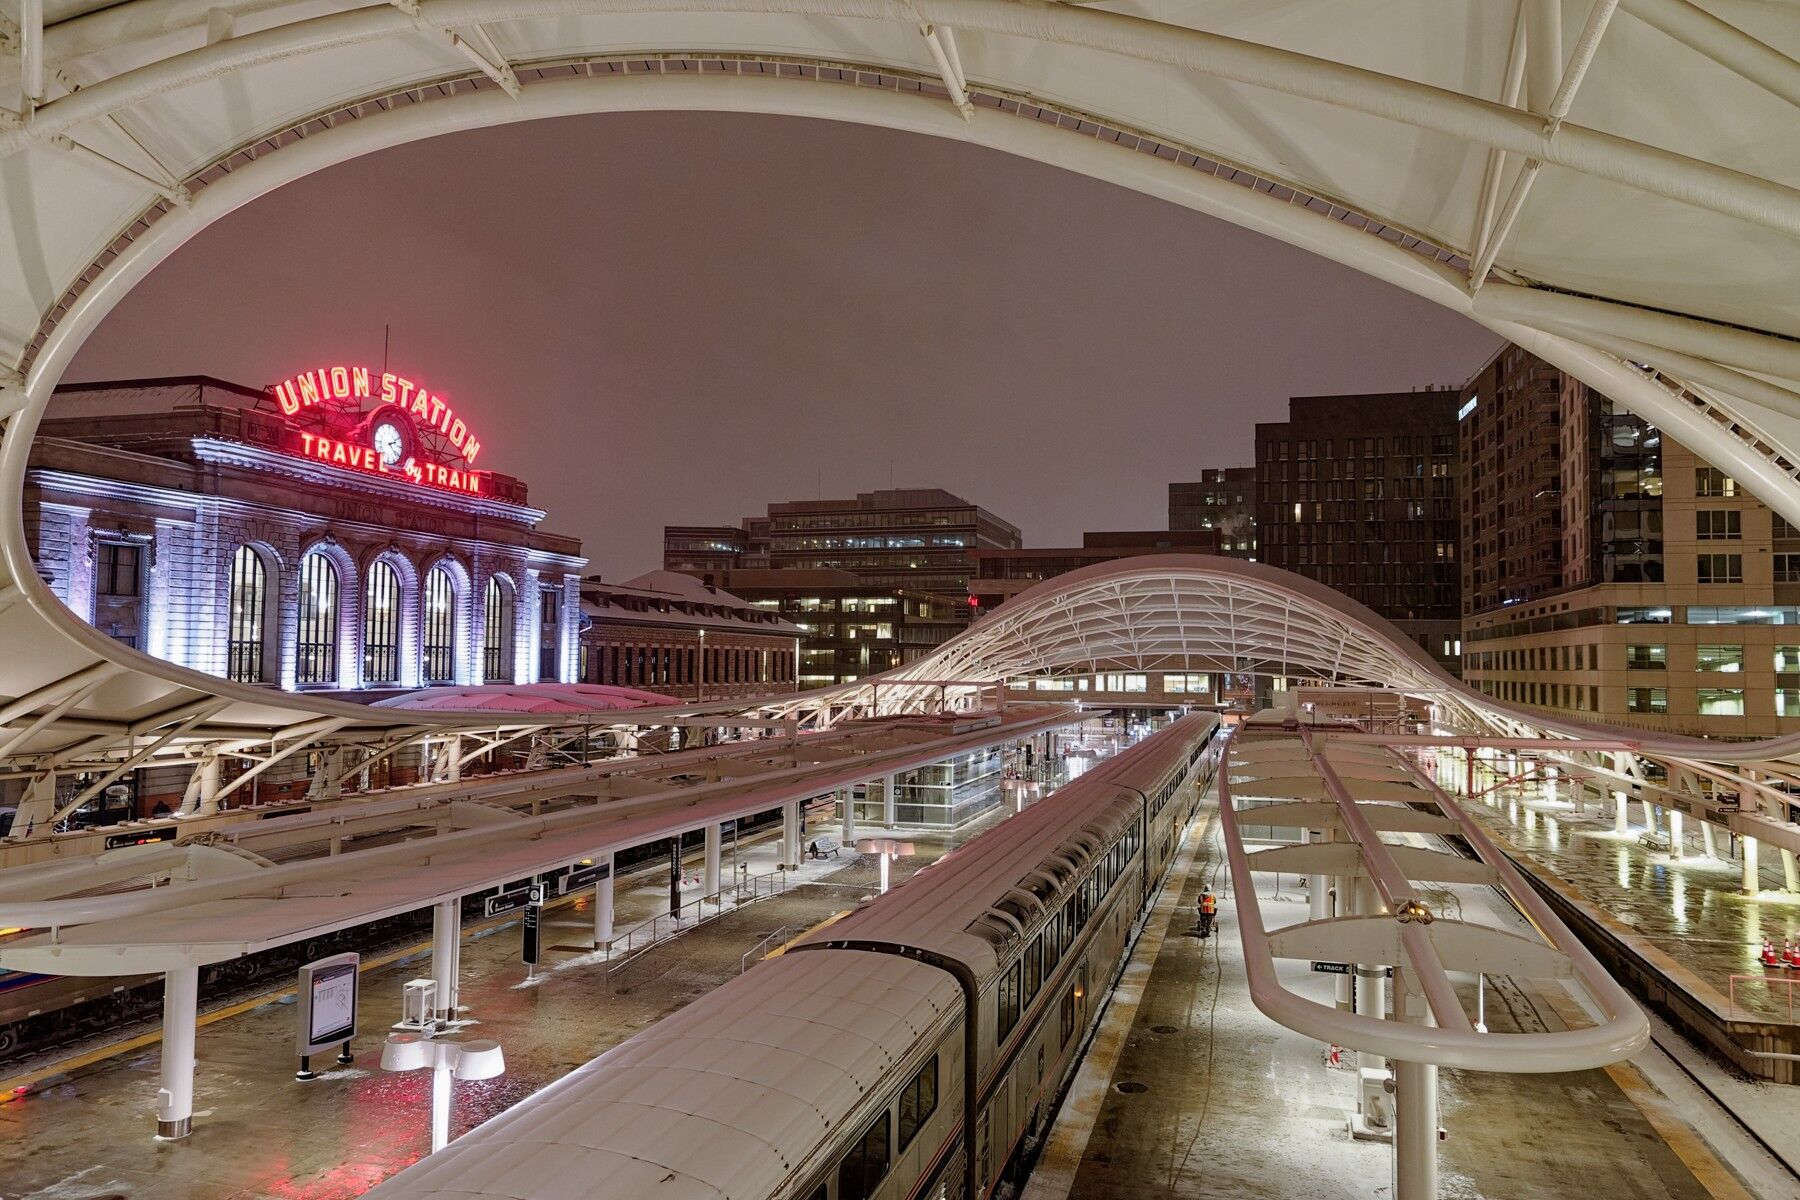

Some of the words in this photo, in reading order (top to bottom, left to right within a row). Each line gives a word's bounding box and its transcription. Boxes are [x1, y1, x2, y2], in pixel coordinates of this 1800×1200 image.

[275, 366, 370, 416] UNION
[381, 372, 480, 464] STATION
[301, 433, 390, 472] TRAVEL
[405, 457, 422, 484] by
[425, 464, 480, 493] TRAIN
